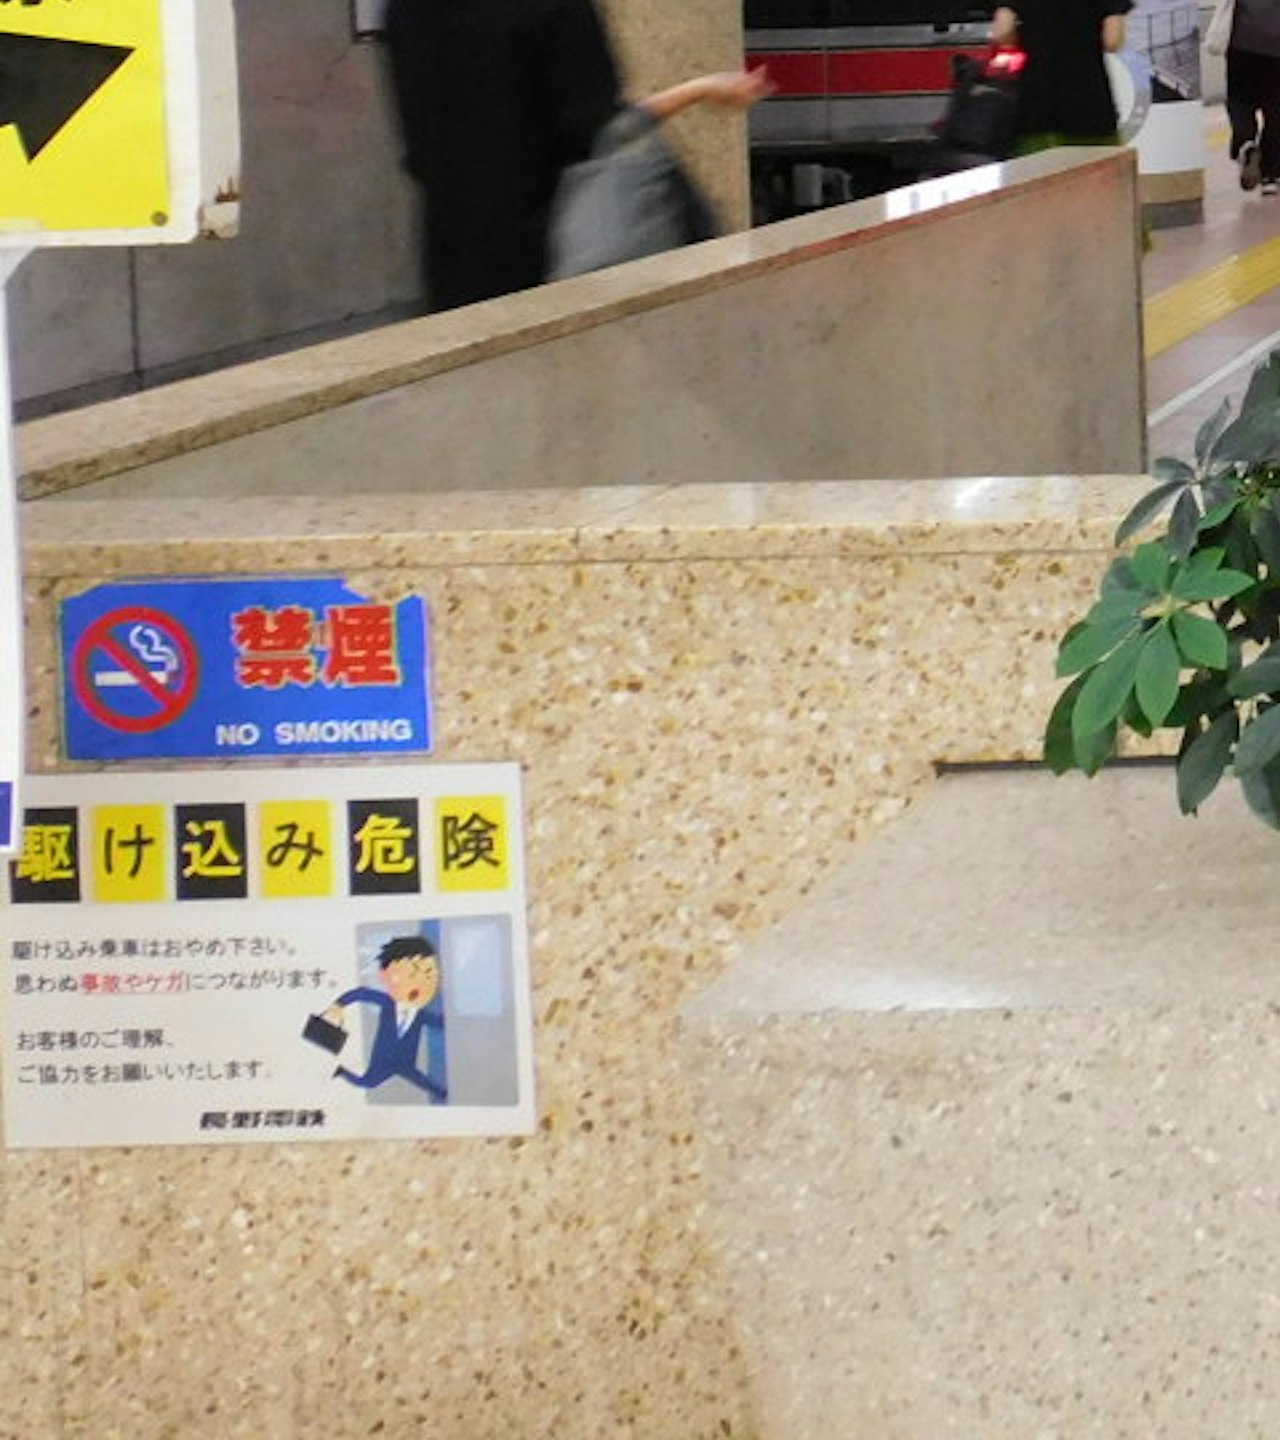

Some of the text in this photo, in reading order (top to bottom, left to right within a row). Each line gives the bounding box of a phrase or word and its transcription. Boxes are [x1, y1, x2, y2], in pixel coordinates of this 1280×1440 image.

[231, 604, 400, 688] 禁煙
[216, 719, 412, 746] NO SMOKING
[17, 814, 500, 883] 駆け込み危険
[12, 933, 298, 960] 駆け込み乗車はおやめ下さい。
